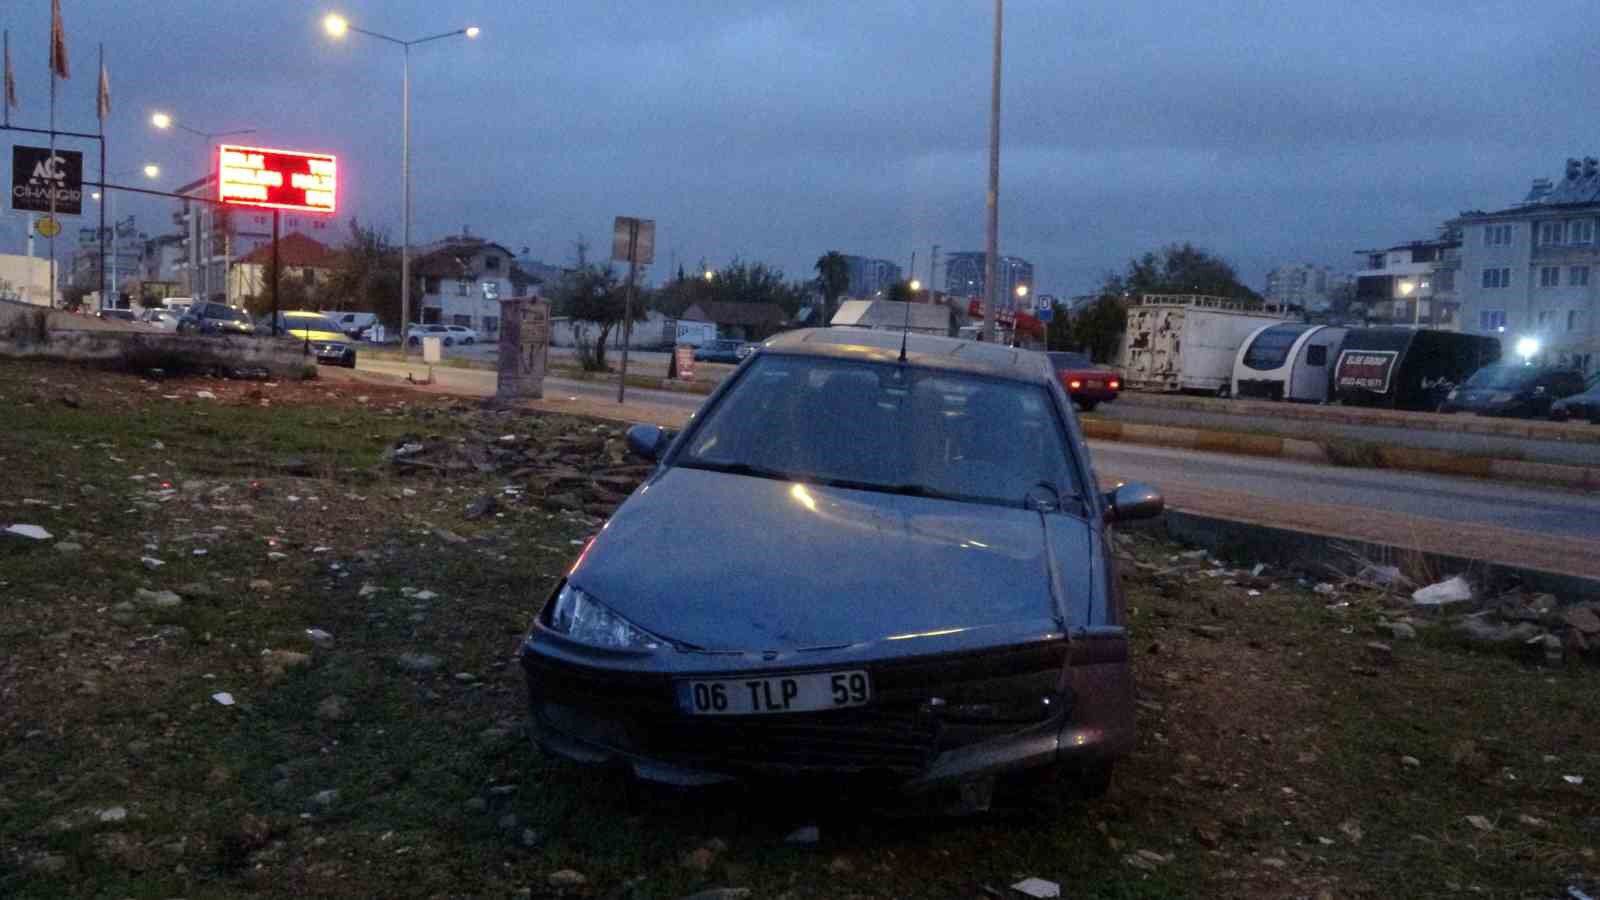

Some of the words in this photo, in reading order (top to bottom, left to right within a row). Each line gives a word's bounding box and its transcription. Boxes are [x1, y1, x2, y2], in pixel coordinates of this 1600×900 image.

[693, 683, 728, 712] 06
[746, 679, 798, 711] TLP
[831, 673, 867, 704] 59
